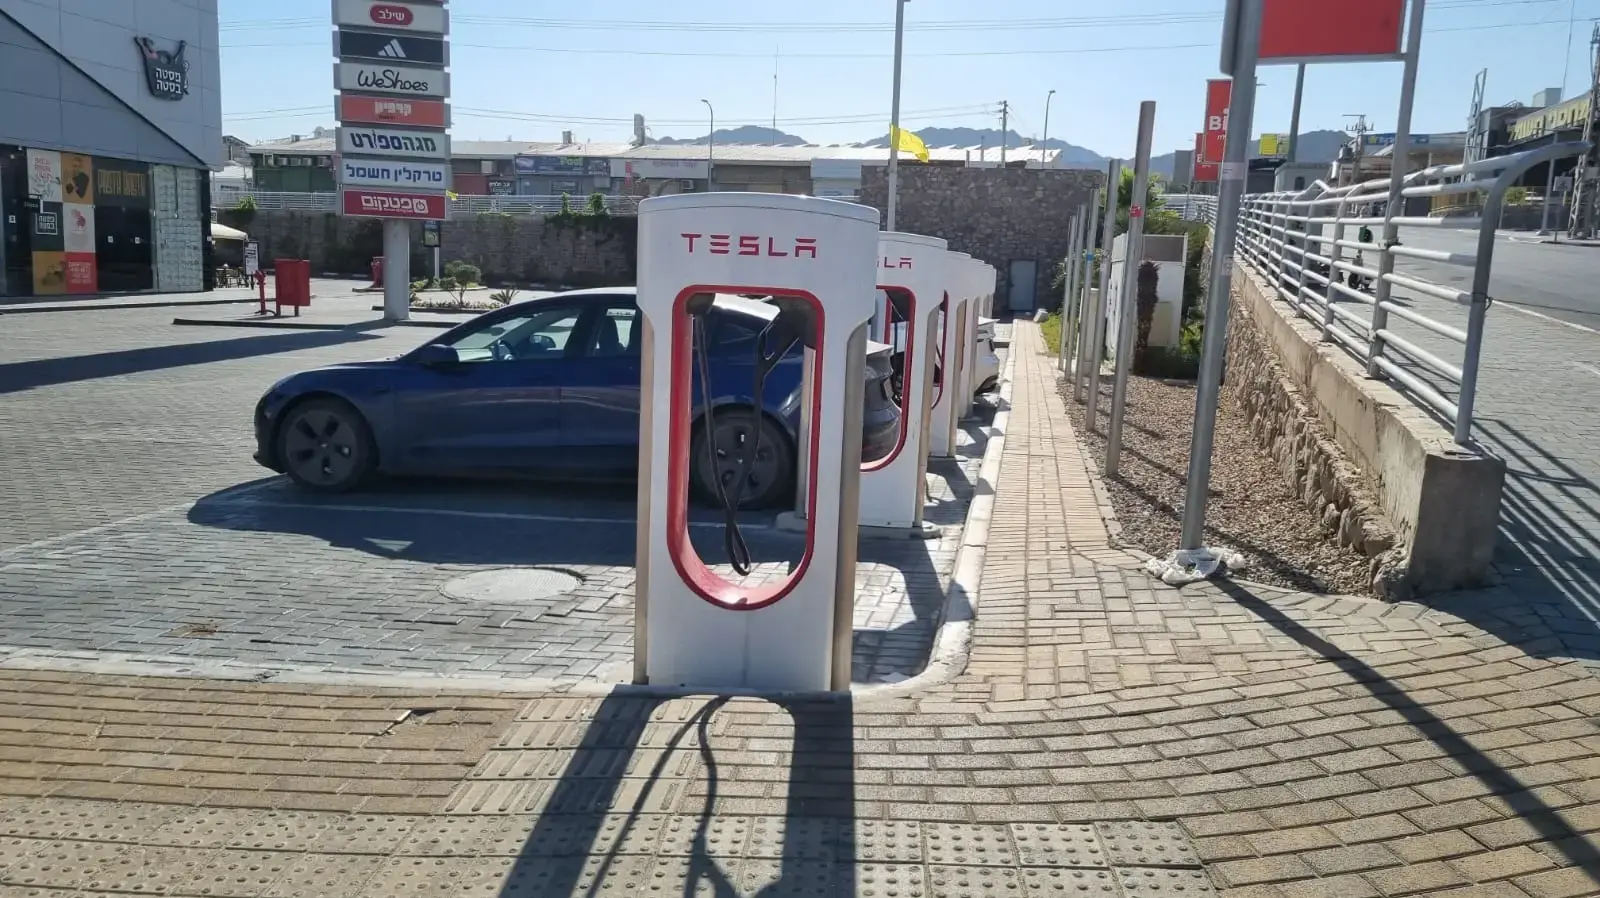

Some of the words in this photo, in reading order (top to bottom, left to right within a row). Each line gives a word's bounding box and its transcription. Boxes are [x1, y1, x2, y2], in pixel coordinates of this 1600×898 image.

[378, 8, 405, 21] שילב
[155, 67, 181, 83] פסטה
[357, 69, 429, 92] WeShoes
[156, 79, 182, 95] בסטה
[1208, 107, 1230, 131] Bi
[346, 163, 391, 180] חשמל
[394, 167, 442, 183] טרקלין
[681, 233, 817, 259] TESLA
